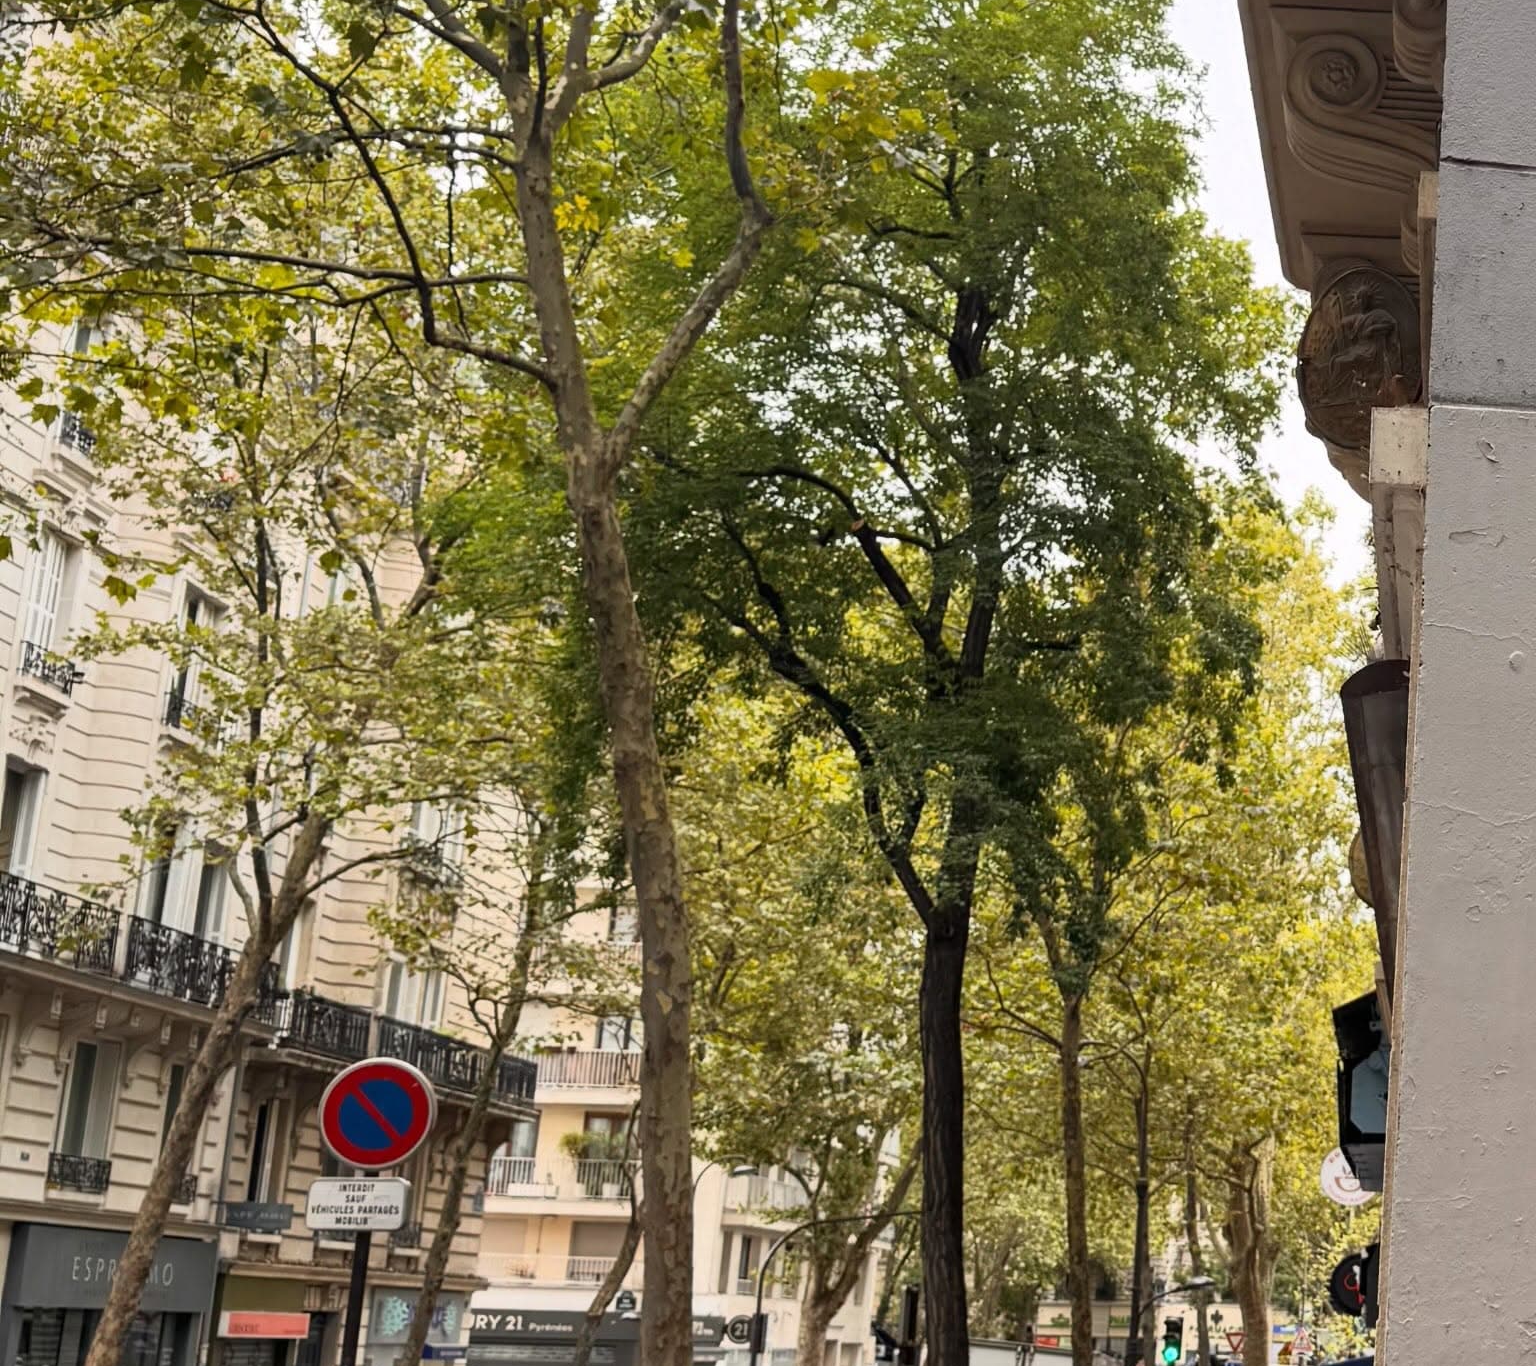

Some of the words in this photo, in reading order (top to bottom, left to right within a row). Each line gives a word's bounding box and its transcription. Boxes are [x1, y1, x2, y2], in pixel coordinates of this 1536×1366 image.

[338, 1183, 375, 1192] INTERDIT
[345, 1194, 367, 1203] SAUF
[311, 1203, 354, 1214] VÉHICULES
[357, 1204, 400, 1215] PARTAGÉS
[505, 1315, 523, 1331] 21
[733, 1322, 749, 1337] 21
